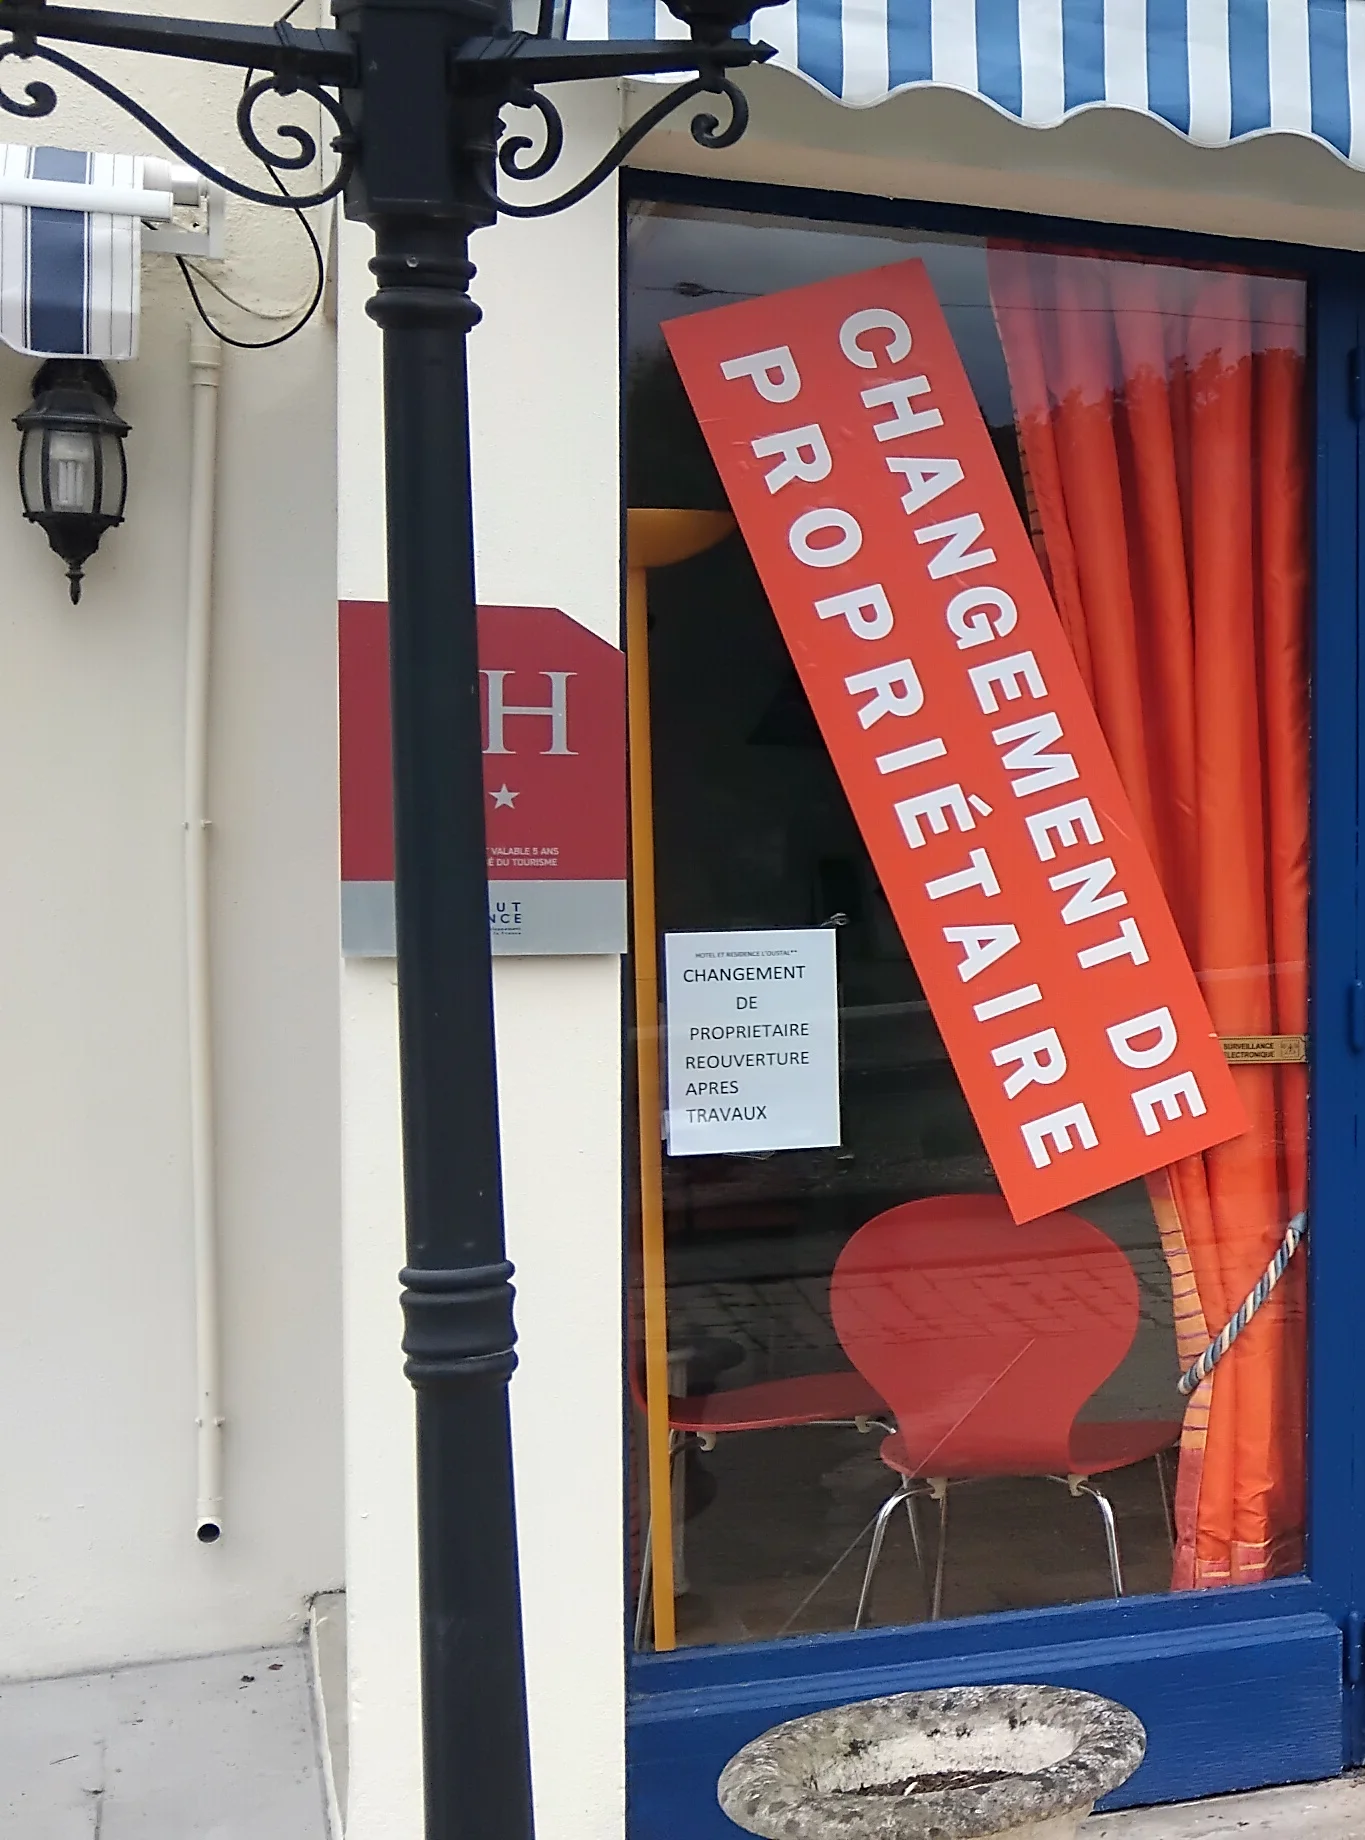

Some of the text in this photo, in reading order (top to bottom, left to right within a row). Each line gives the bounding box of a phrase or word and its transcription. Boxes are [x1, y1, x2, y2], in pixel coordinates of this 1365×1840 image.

[479, 669, 579, 756] H
[838, 307, 1206, 1136] CHANGEMENT DE
[720, 345, 1099, 1169] PROPRIÉTAIRE
[491, 847, 530, 855] VALABLE
[540, 847, 559, 855] ANS
[511, 858, 558, 867] TOURISME
[489, 913, 522, 924] NCE
[683, 965, 806, 983] CHANGEMENT
[736, 996, 758, 1010] DE
[690, 1023, 810, 1041] PROPRIETAIRE
[1223, 1042, 1274, 1050] SURVEILLANCE
[685, 1051, 810, 1070] REOUVERTURE
[685, 1080, 739, 1096] APRES
[685, 1105, 767, 1124] TRAVAUX
